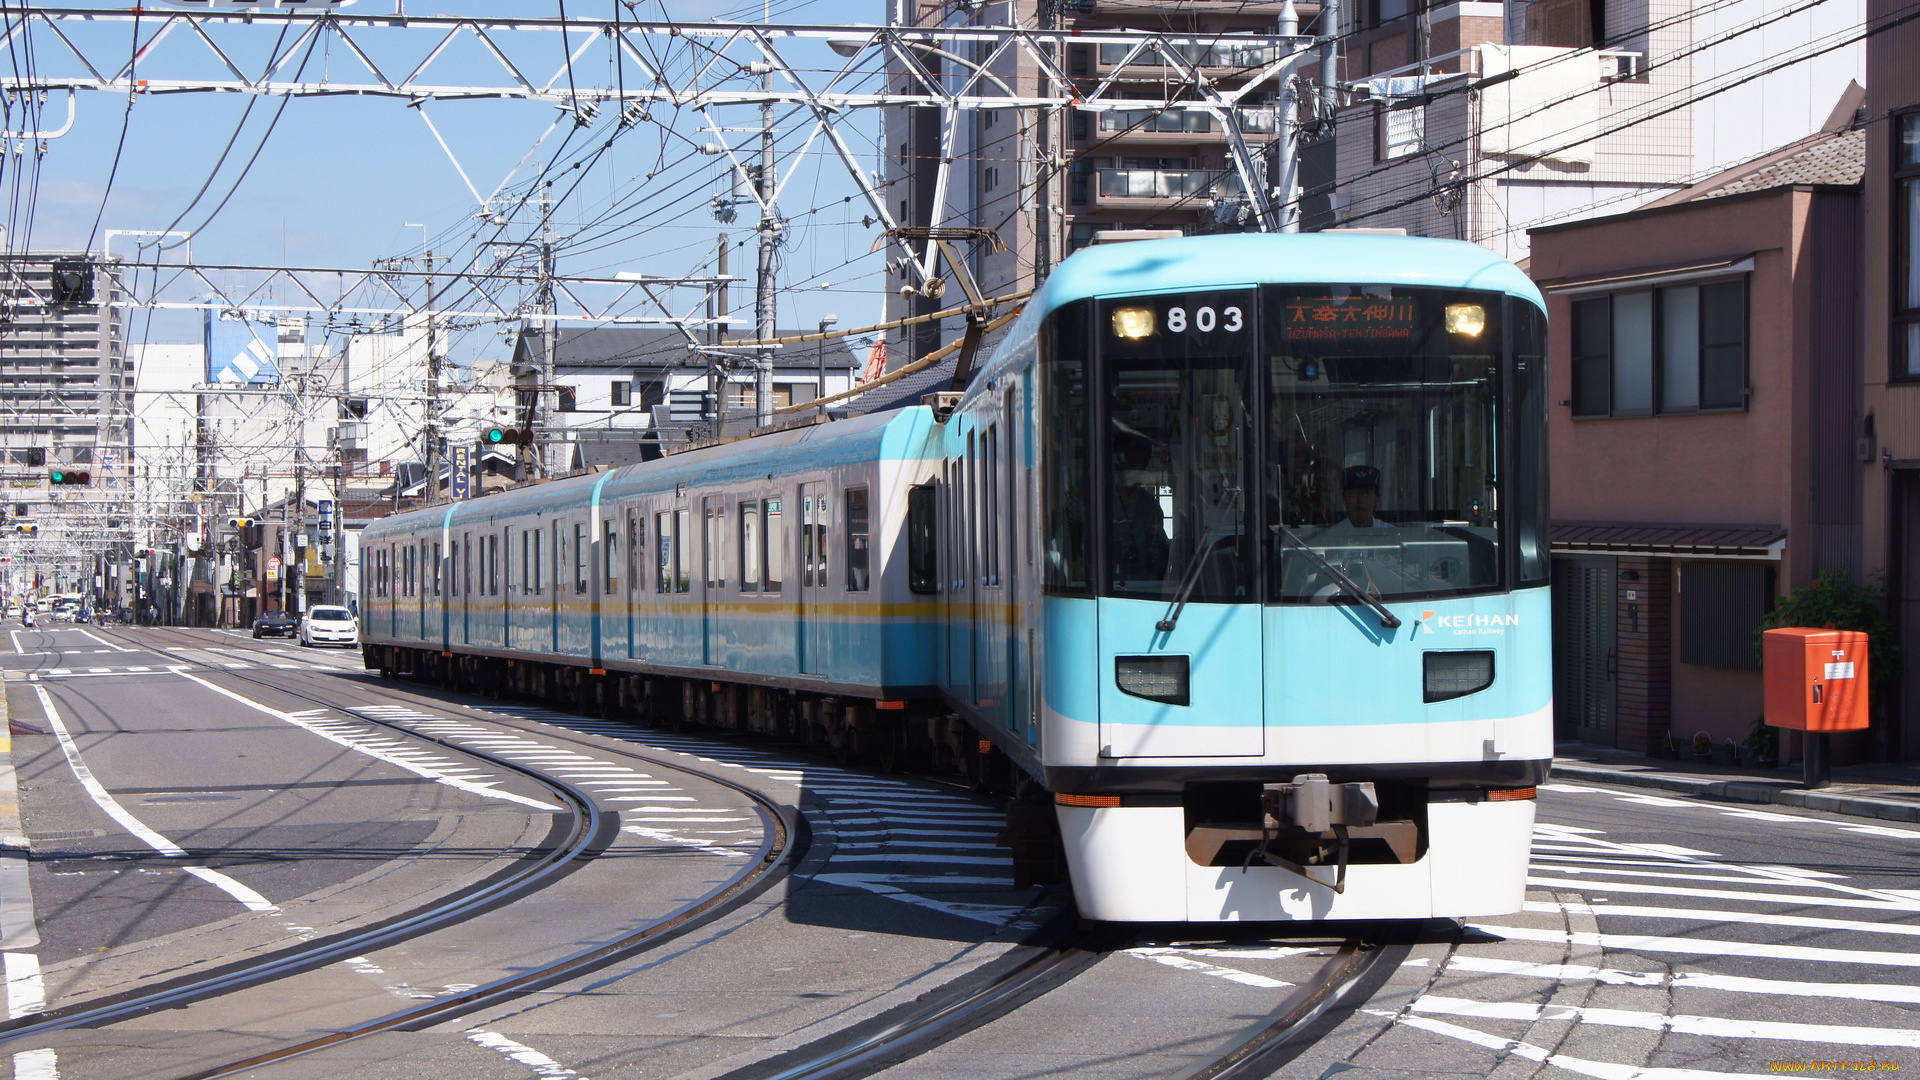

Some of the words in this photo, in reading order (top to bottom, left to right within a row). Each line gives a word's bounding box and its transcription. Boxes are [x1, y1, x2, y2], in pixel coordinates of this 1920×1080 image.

[1167, 306, 1243, 333] 803
[1287, 326, 1412, 339] UZUMASA-TENJINGAWA
[456, 447, 466, 483] RENTAL
[1438, 613, 1519, 628] KEIHAN
[1453, 628, 1477, 636] Keihan
[1478, 628, 1505, 636] Railway
